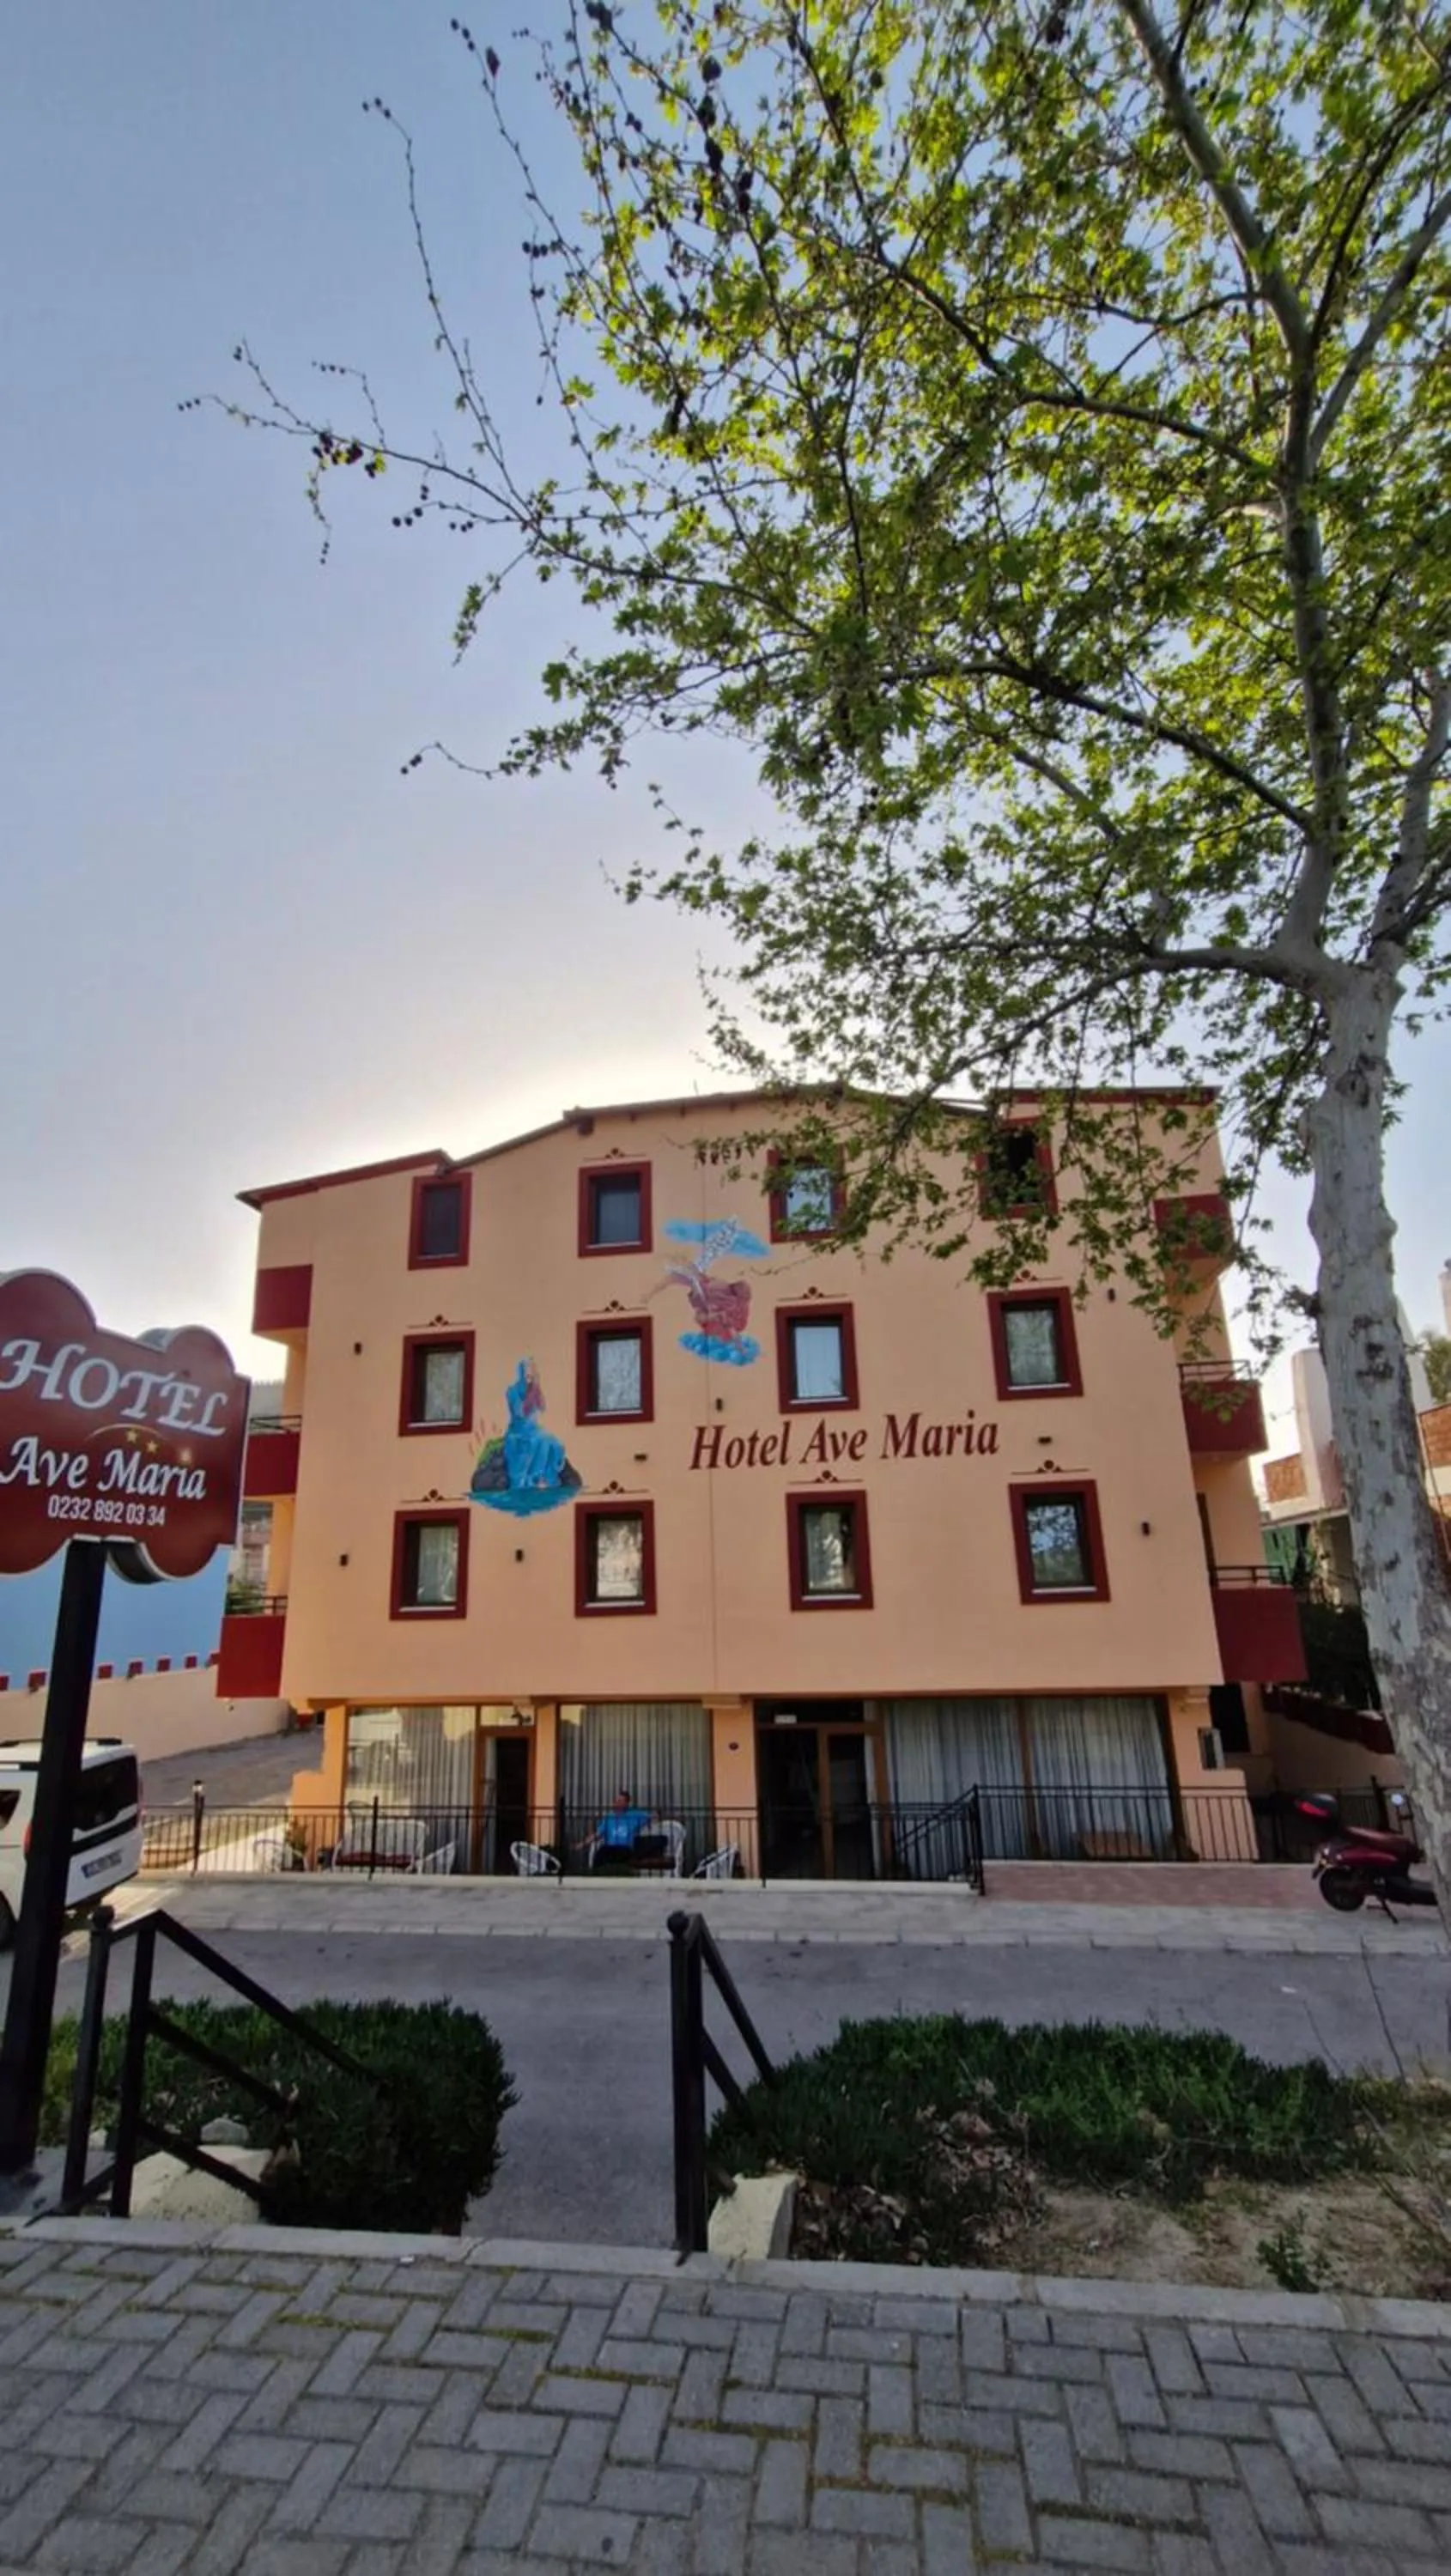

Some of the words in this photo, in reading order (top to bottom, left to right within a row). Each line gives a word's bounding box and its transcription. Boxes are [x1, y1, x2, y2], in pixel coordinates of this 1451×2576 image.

[0, 1340, 228, 1436] HOTEL
[0, 1437, 89, 1489] Ave
[97, 1449, 206, 1500] Maria
[689, 1421, 791, 1470] Hotel
[799, 1419, 868, 1465] Ave
[879, 1409, 999, 1459] Maria
[48, 1495, 90, 1521] 0232
[93, 1499, 124, 1523] 892
[125, 1504, 144, 1524] 03
[147, 1505, 165, 1526] 34
